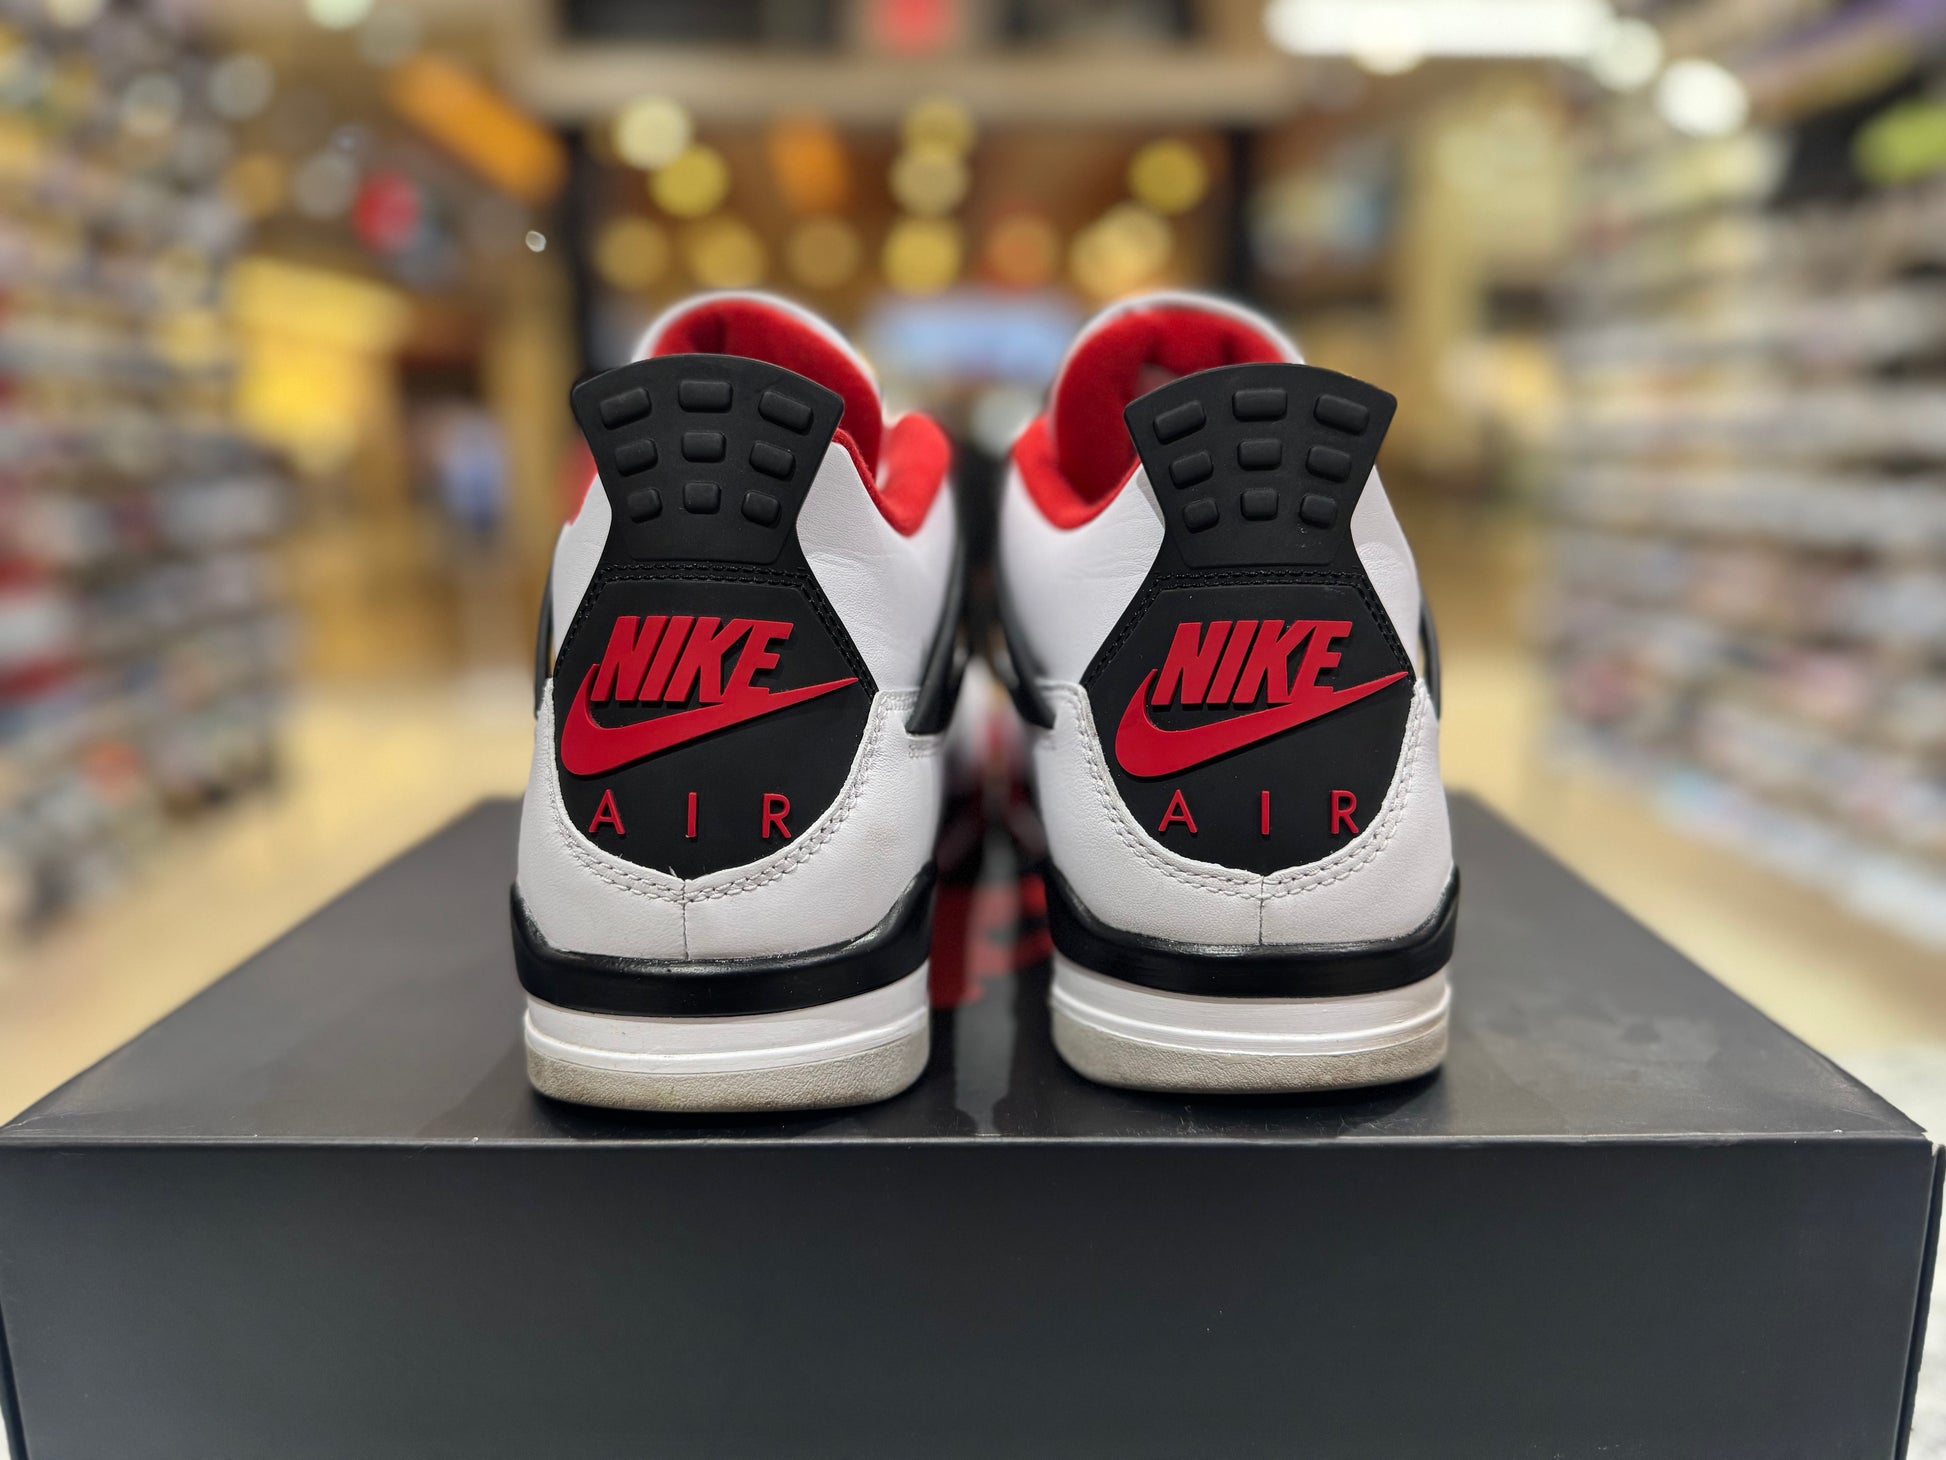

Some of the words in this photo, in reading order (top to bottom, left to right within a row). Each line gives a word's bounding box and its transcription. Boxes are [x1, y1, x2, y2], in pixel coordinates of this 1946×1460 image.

[590, 615, 795, 703] NIKE
[1150, 619, 1353, 706] NIKE
[588, 789, 792, 839] AIR
[1157, 788, 1359, 835] AIR
